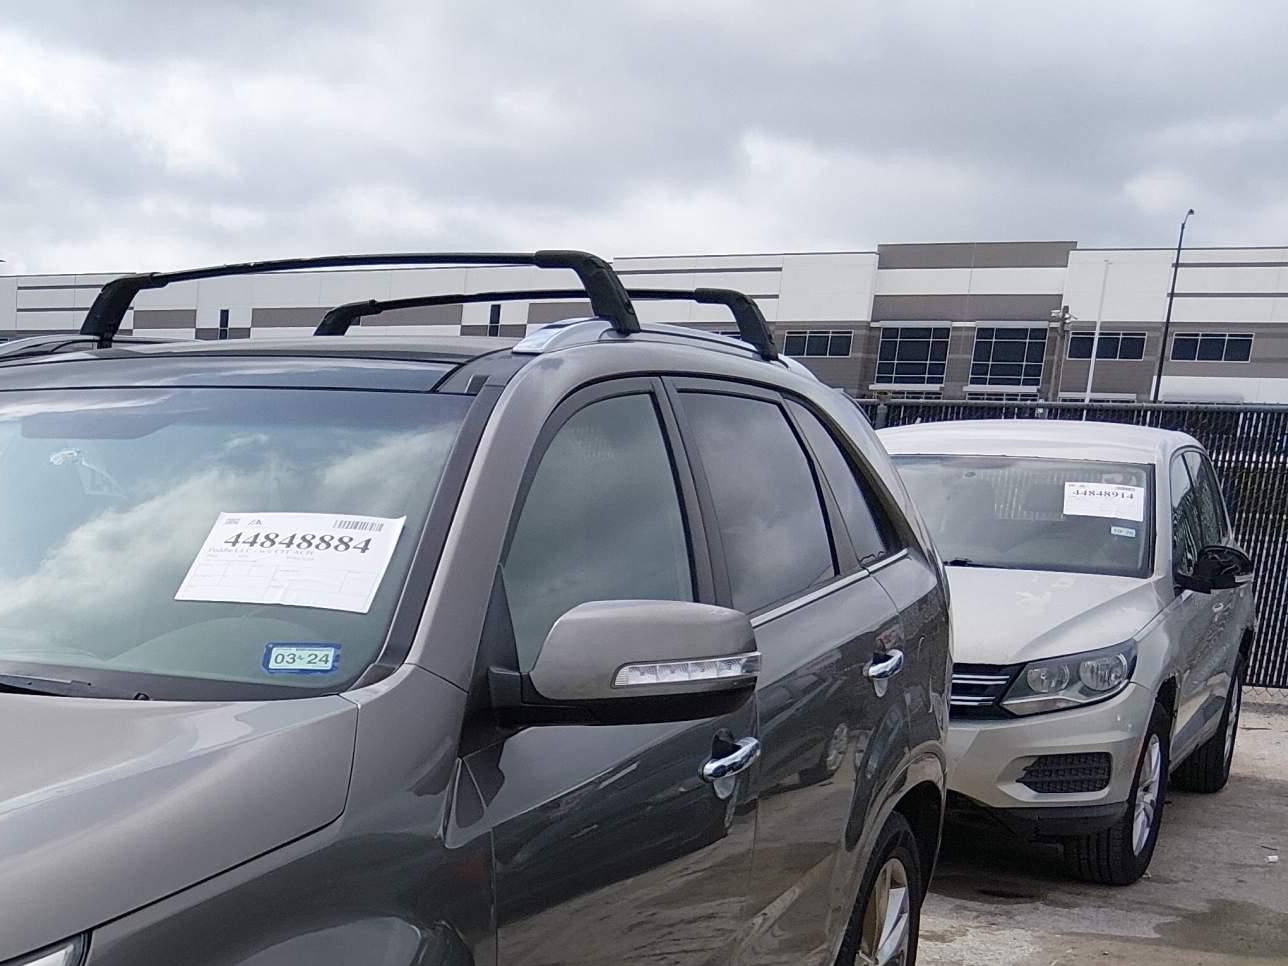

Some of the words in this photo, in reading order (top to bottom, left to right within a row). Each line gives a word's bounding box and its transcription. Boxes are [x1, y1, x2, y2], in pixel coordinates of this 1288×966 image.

[223, 531, 373, 554] 44848884
[274, 652, 297, 665] 03
[306, 652, 330, 665] 24
